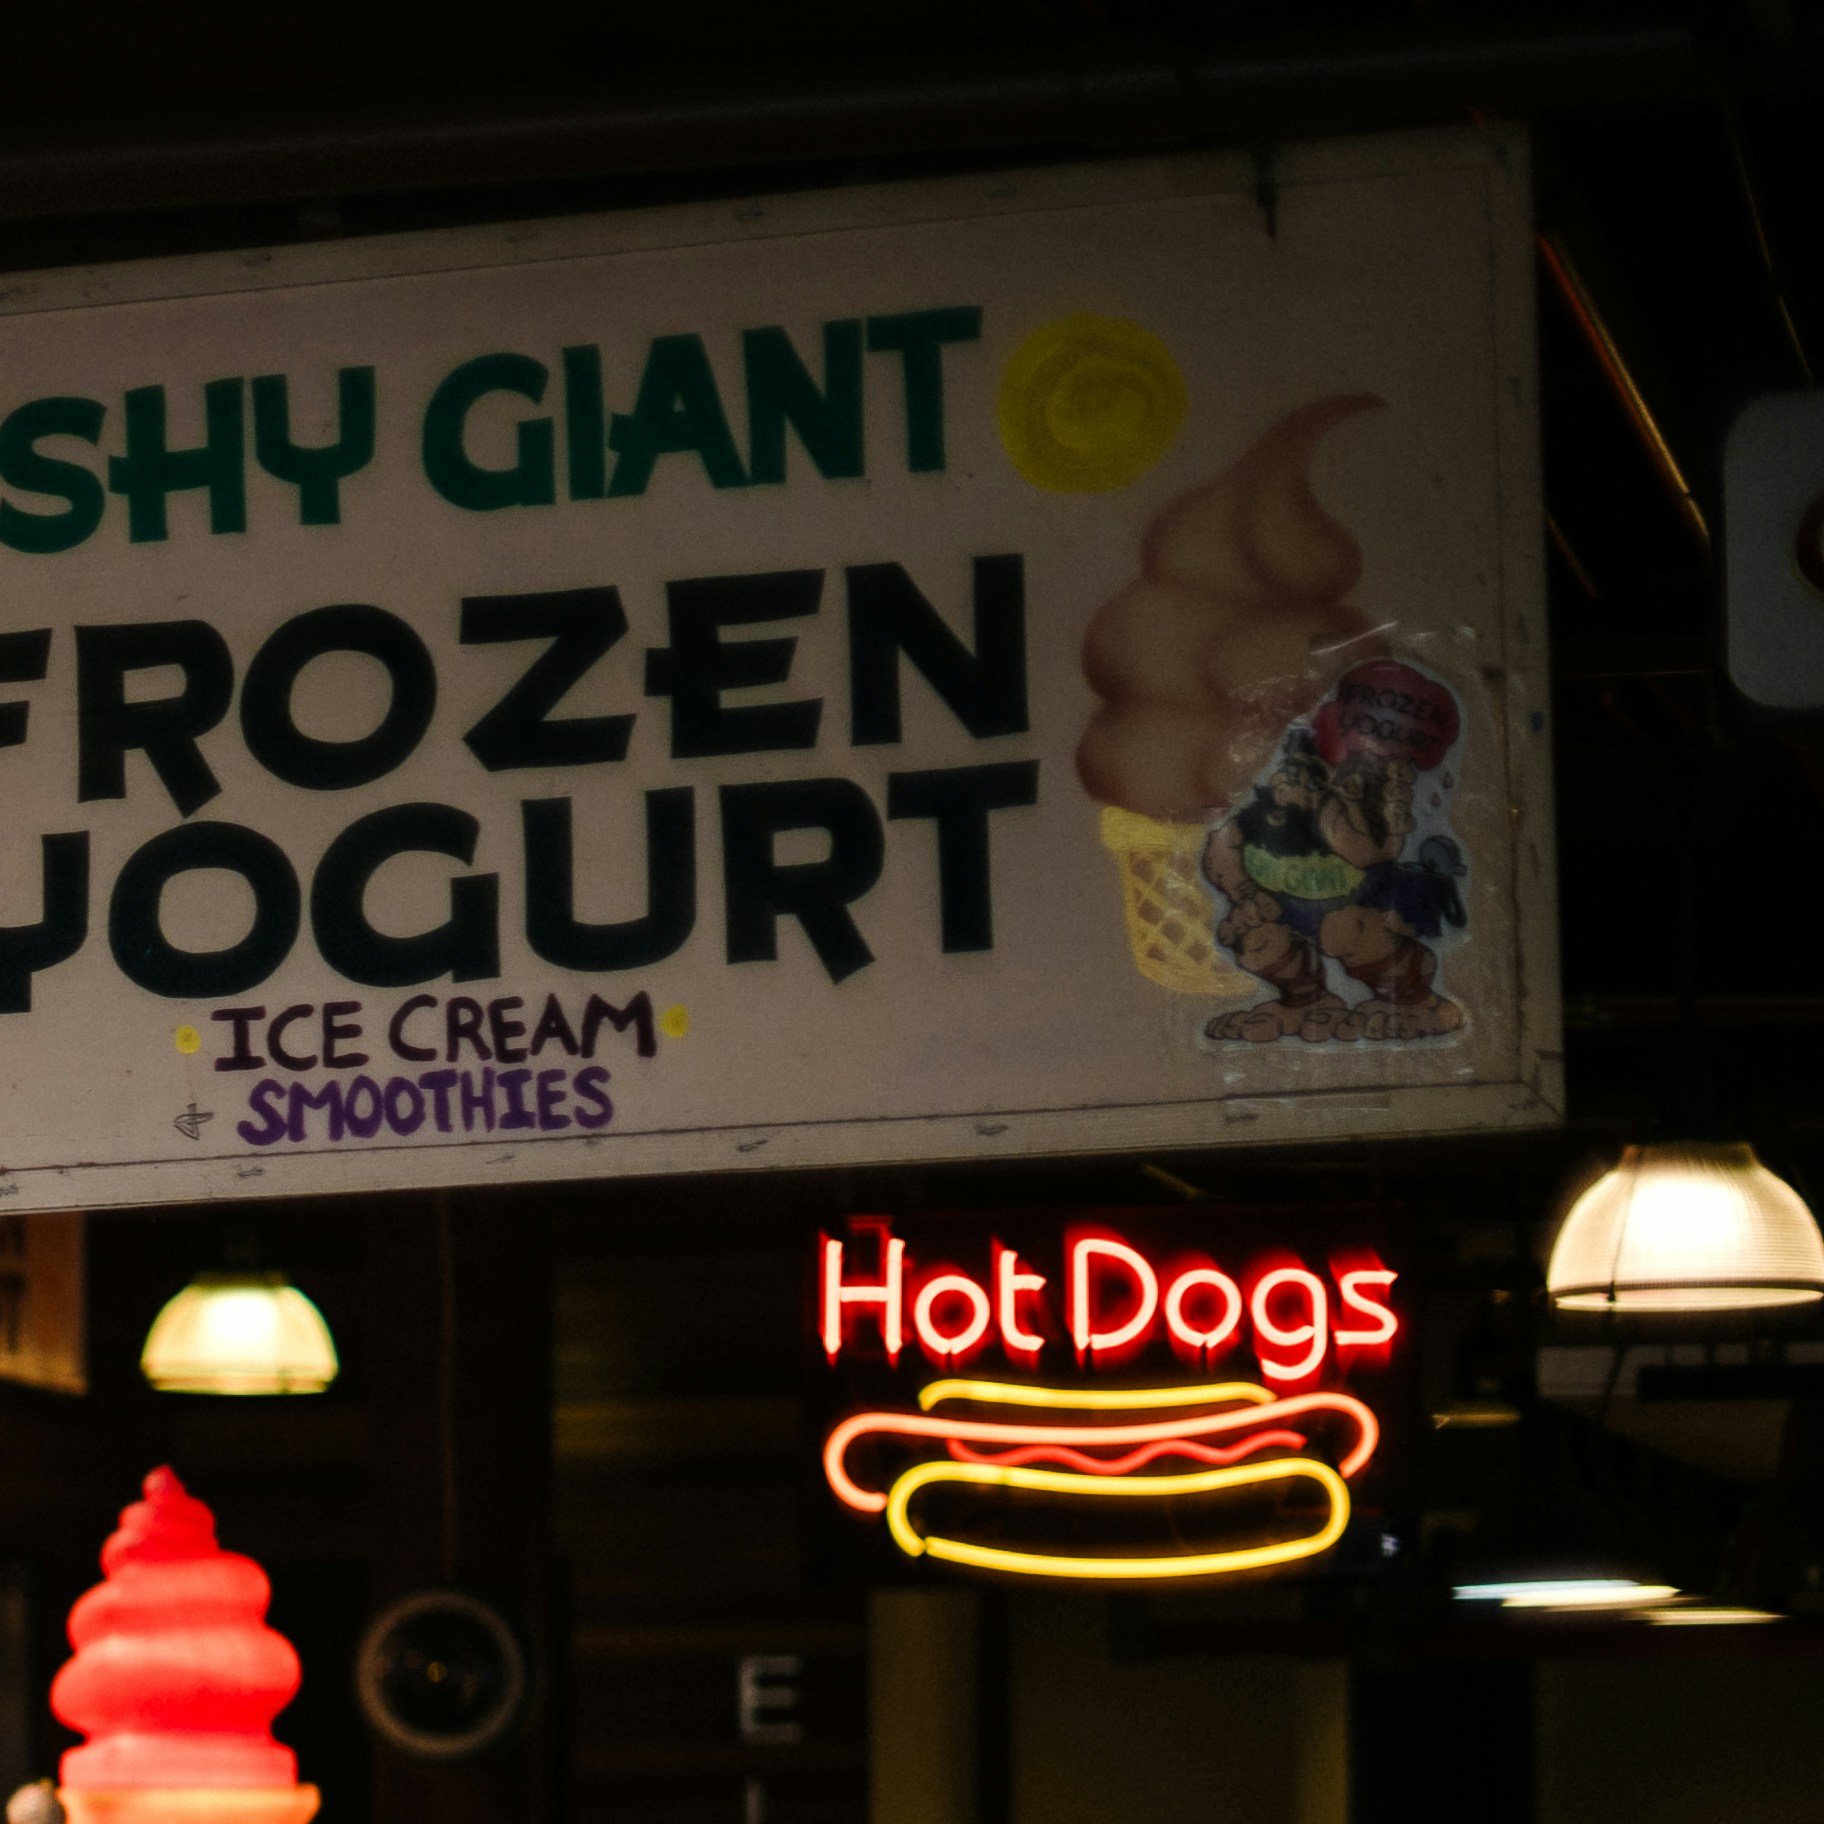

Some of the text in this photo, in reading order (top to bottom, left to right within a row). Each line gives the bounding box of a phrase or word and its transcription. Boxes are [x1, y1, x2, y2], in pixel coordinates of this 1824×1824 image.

[419, 305, 984, 514] GIANT
[1338, 683, 1449, 724] FROZEN
[210, 990, 658, 1072] ICE CREAM
[236, 1066, 615, 1147] SMOOTHIES
[822, 1235, 1400, 1382] Hot Dogs
